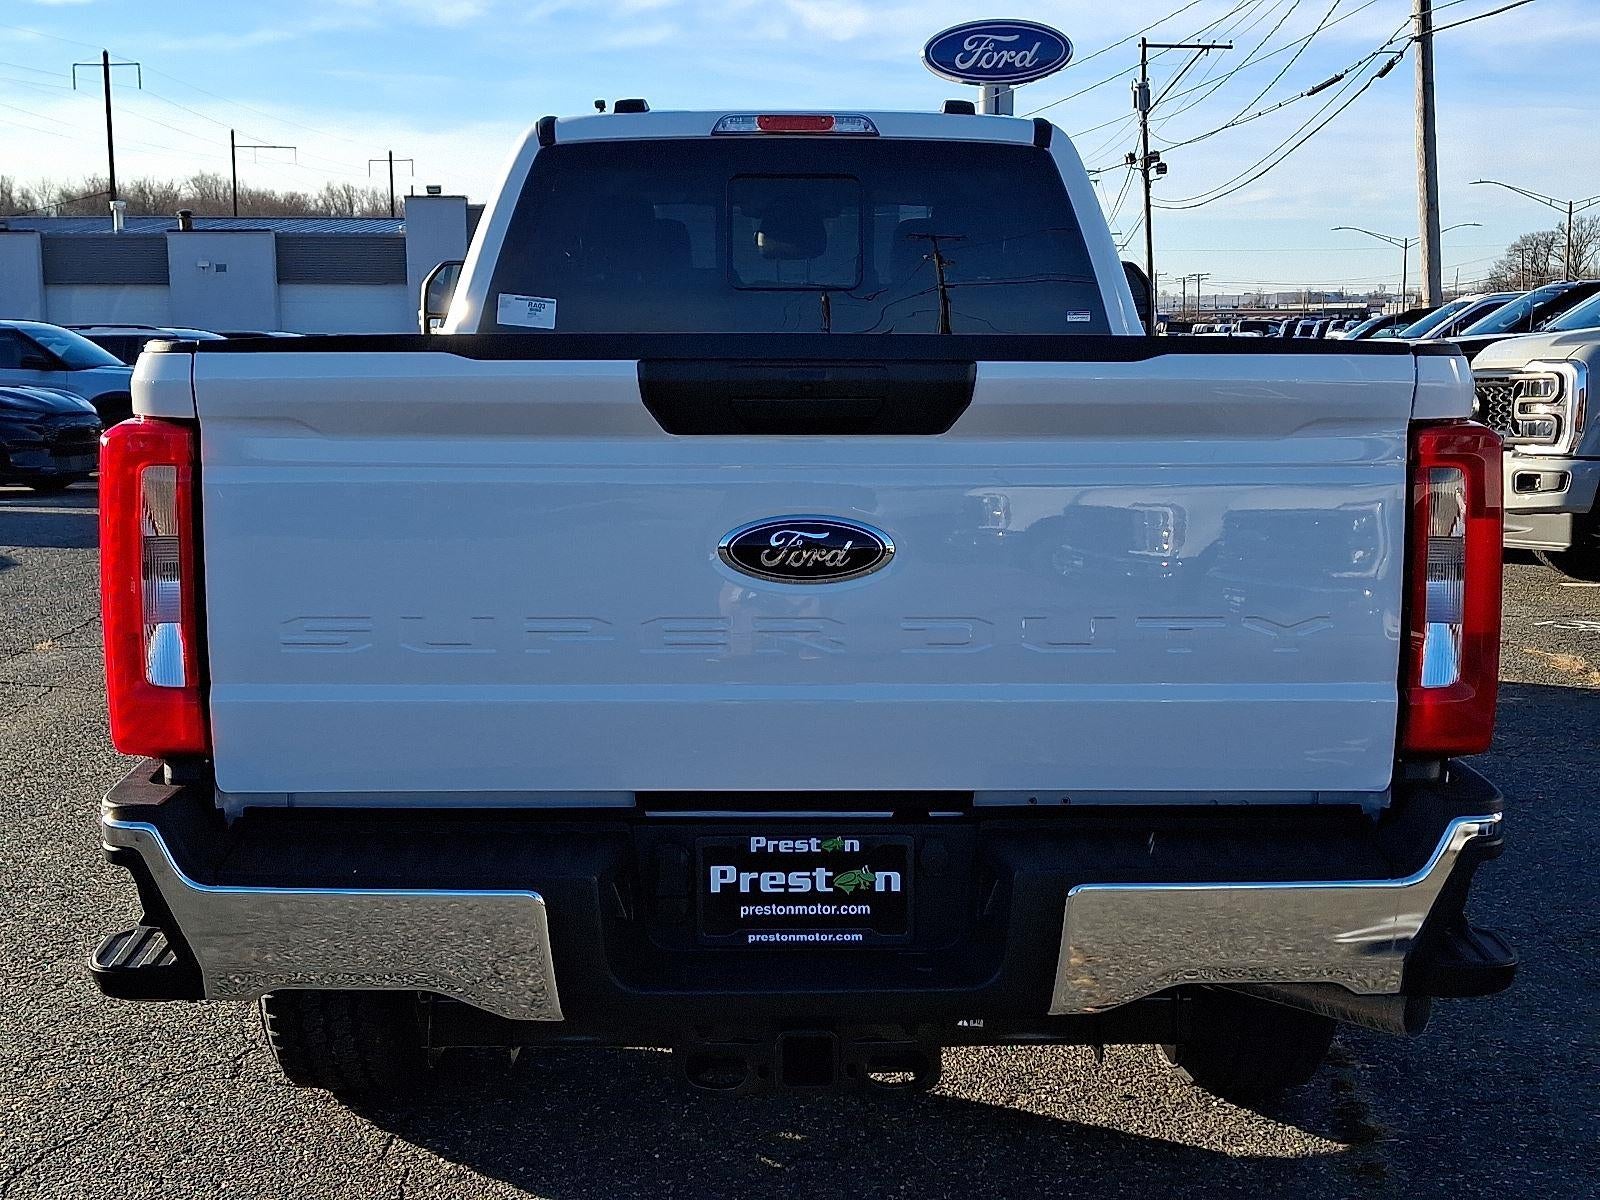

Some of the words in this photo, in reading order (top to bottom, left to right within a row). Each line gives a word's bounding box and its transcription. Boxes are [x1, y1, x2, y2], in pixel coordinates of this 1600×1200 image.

[955, 34, 1042, 70] Ford
[760, 530, 853, 567] Ford
[280, 616, 846, 654] SUPER
[900, 616, 1335, 654] DUTY
[740, 903, 871, 918] prestonmotor.com
[748, 933, 863, 944] prestonmotor.com
